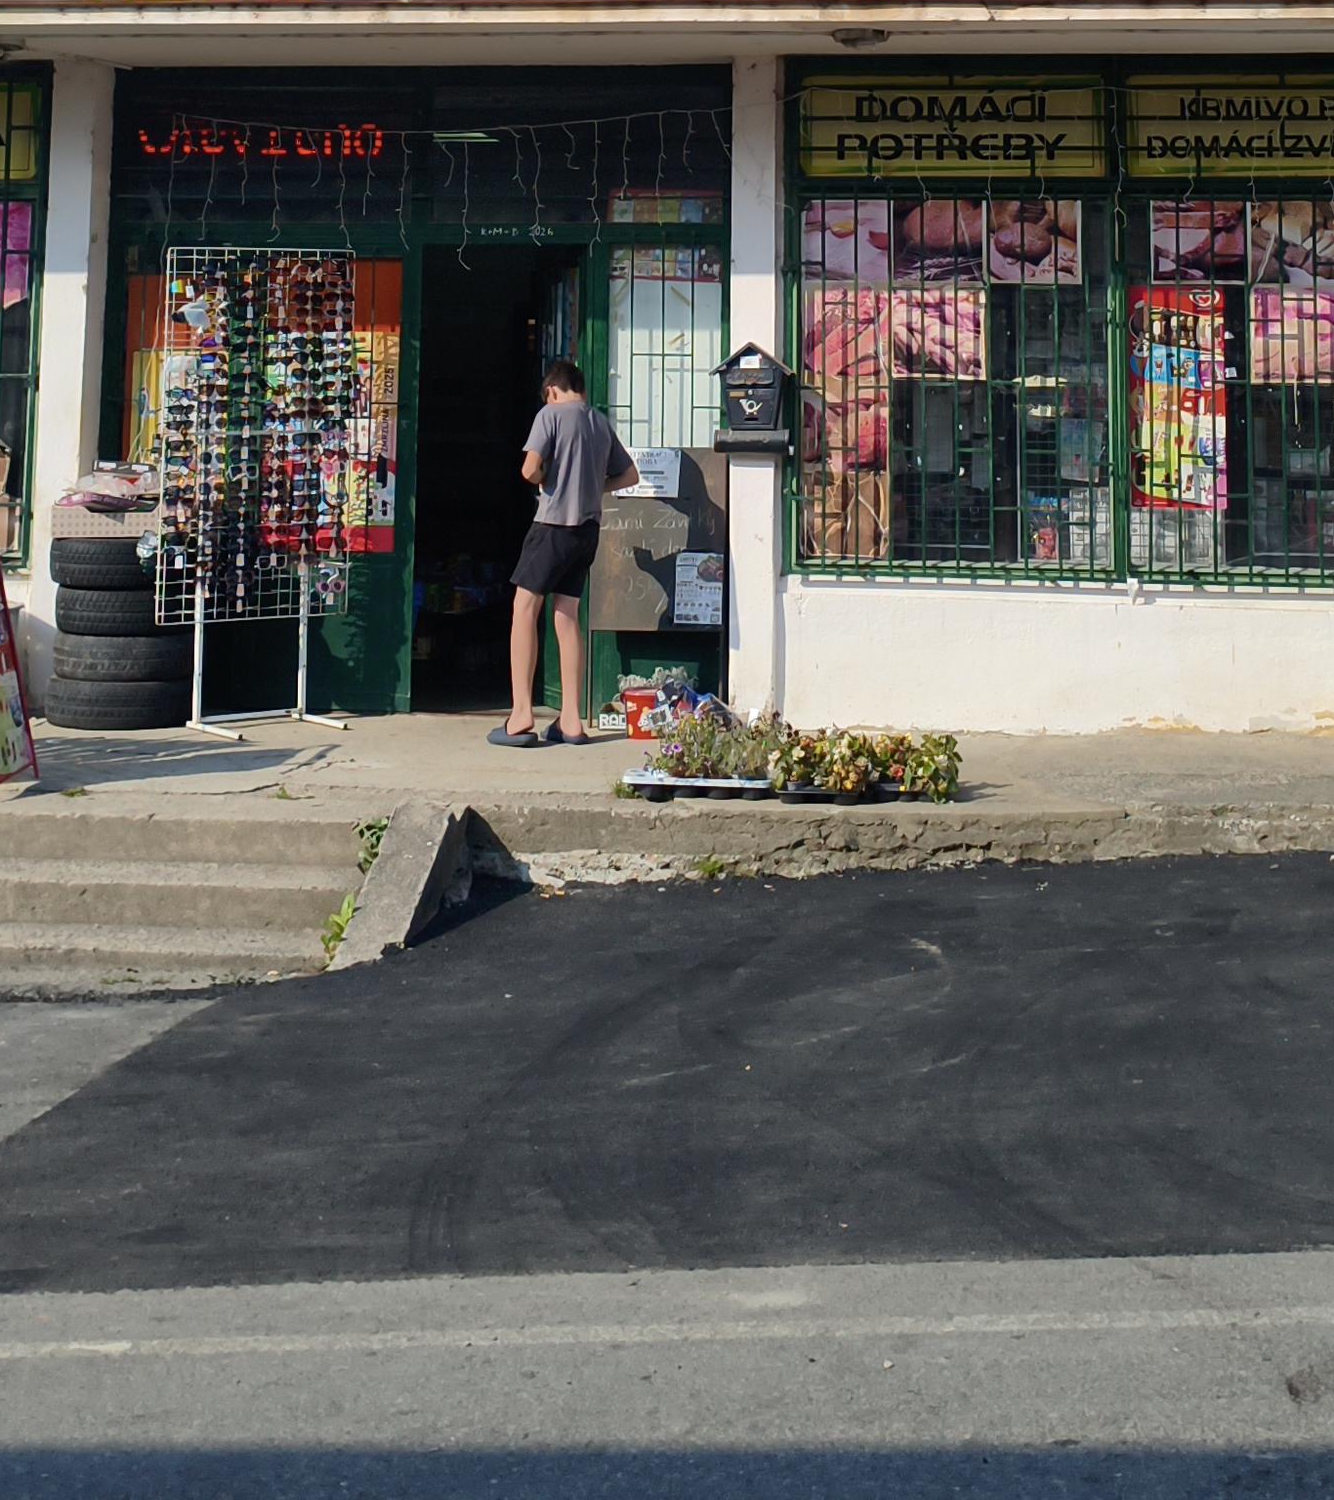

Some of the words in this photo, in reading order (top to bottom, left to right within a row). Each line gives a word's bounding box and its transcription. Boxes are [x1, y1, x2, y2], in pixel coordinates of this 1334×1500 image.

[1179, 95, 1309, 120] KRMIVO
[836, 127, 1067, 161] POTŘEBY
[1146, 129, 1274, 159] DOMÁCÍ
